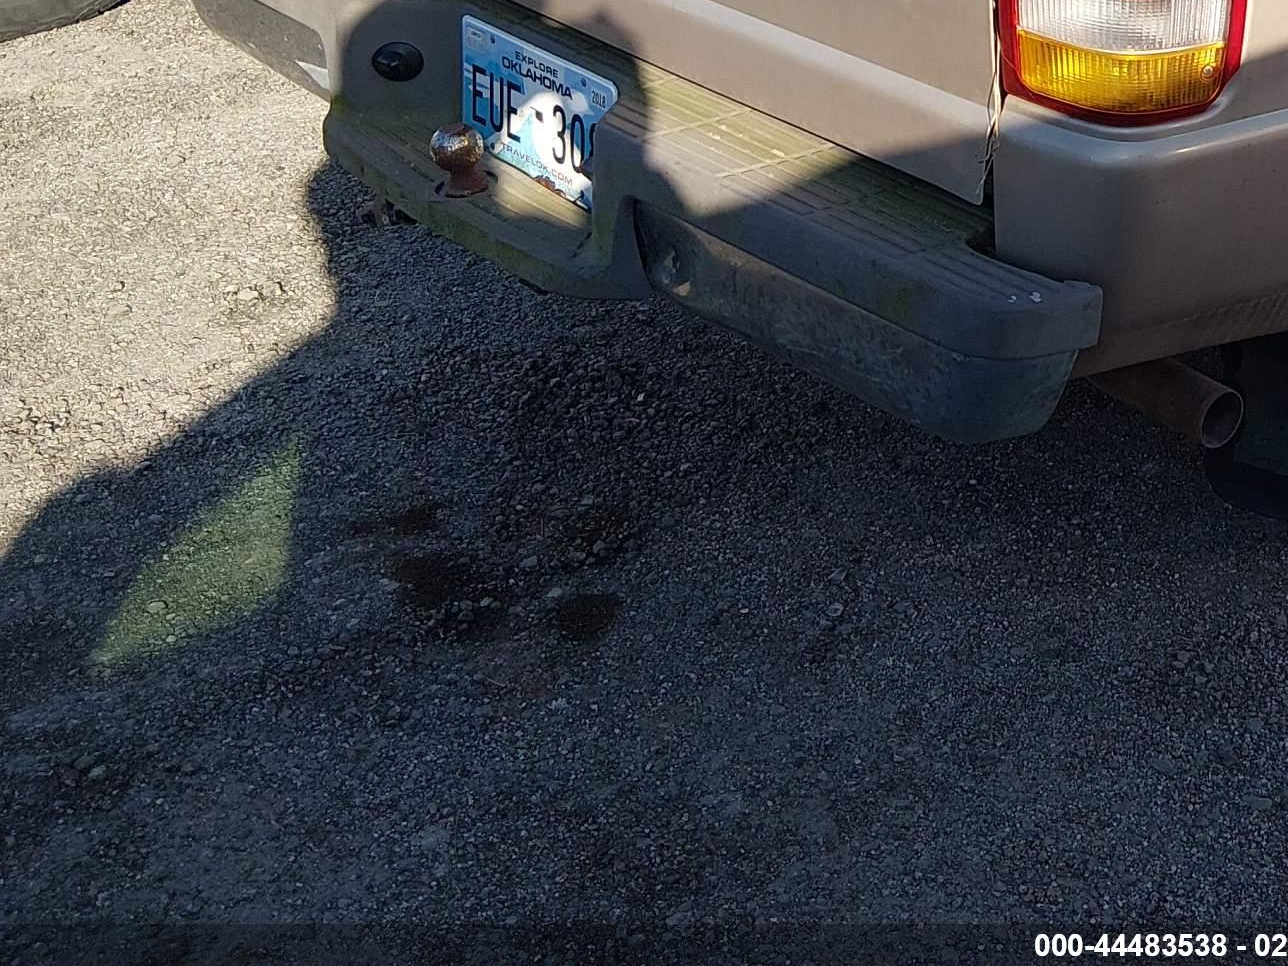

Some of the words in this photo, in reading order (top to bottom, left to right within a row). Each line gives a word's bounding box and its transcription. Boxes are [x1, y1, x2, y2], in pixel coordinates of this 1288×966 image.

[501, 56, 573, 100] OKLAHOMA
[515, 50, 559, 78] EXPLORE
[471, 64, 526, 144] EUE
[501, 143, 574, 187] TRAVELOK.COM
